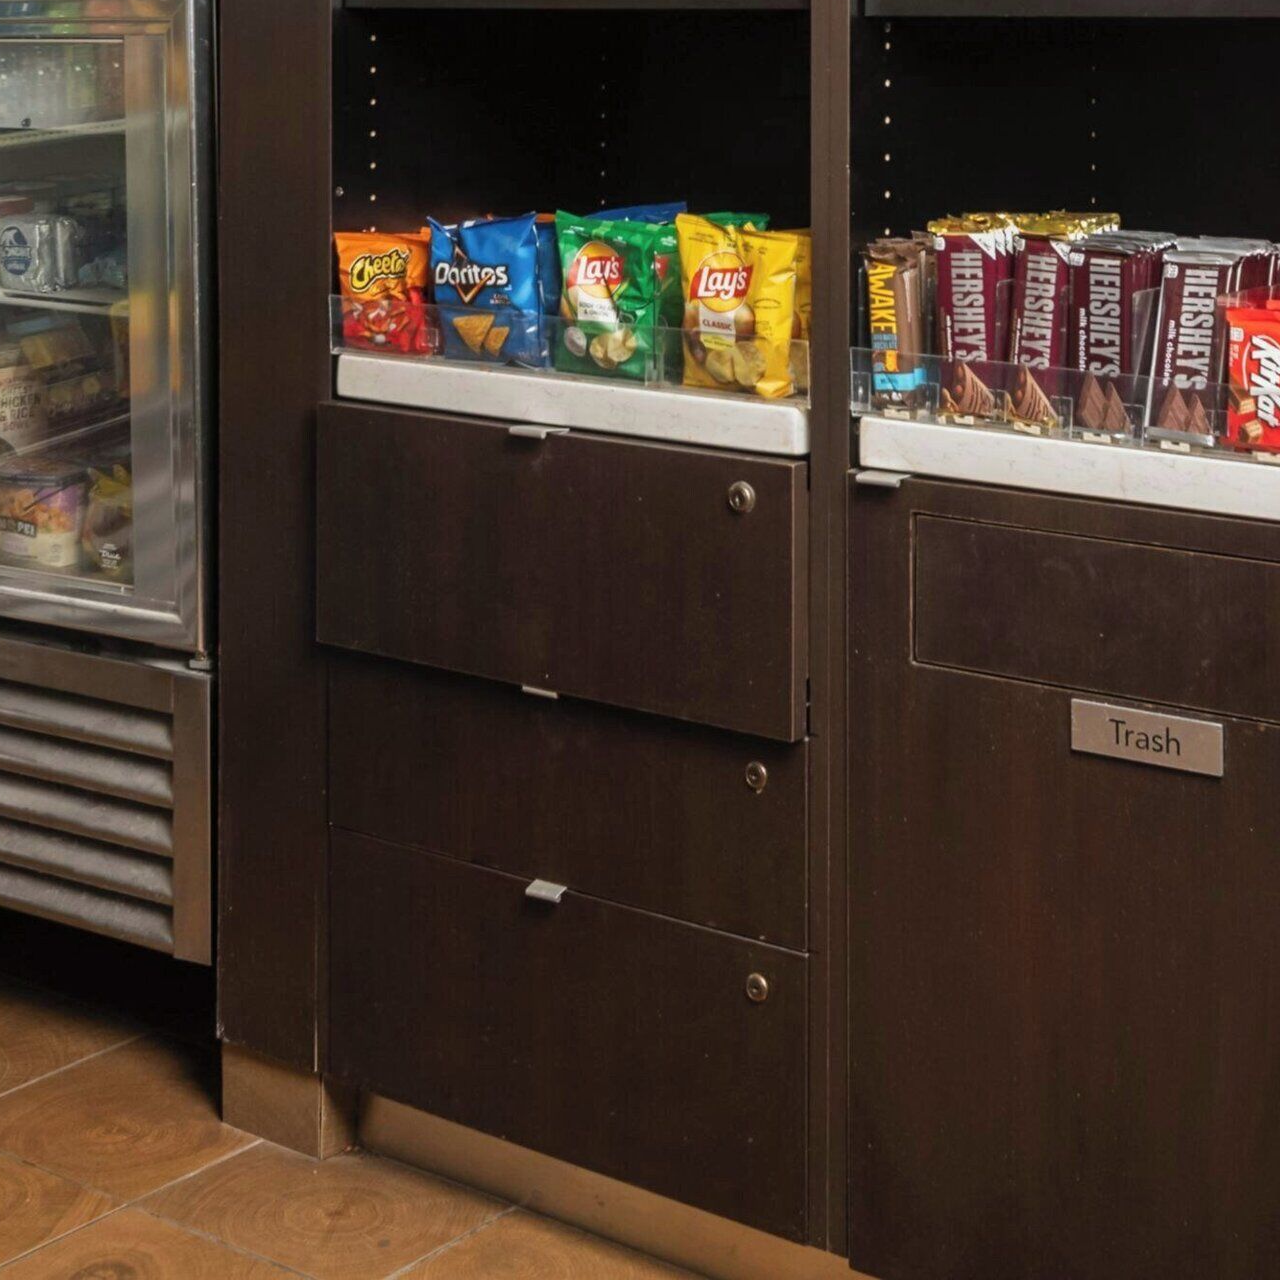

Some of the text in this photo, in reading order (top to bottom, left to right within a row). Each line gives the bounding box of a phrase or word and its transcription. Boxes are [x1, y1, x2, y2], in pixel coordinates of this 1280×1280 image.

[435, 263, 508, 285] Doritos
[697, 265, 747, 300] Lay's
[869, 262, 897, 333] AWAKE
[702, 320, 732, 330] CLASSIC
[950, 252, 988, 362] HERSHEY'S
[1020, 254, 1059, 369] HERSHEY'S
[1079, 307, 1087, 324] milk
[1089, 257, 1121, 378] HERSHEY'S
[1174, 268, 1219, 390] HERSHEY'S
[1163, 337, 1174, 387] chocolate
[1109, 718, 1181, 756] Trash
